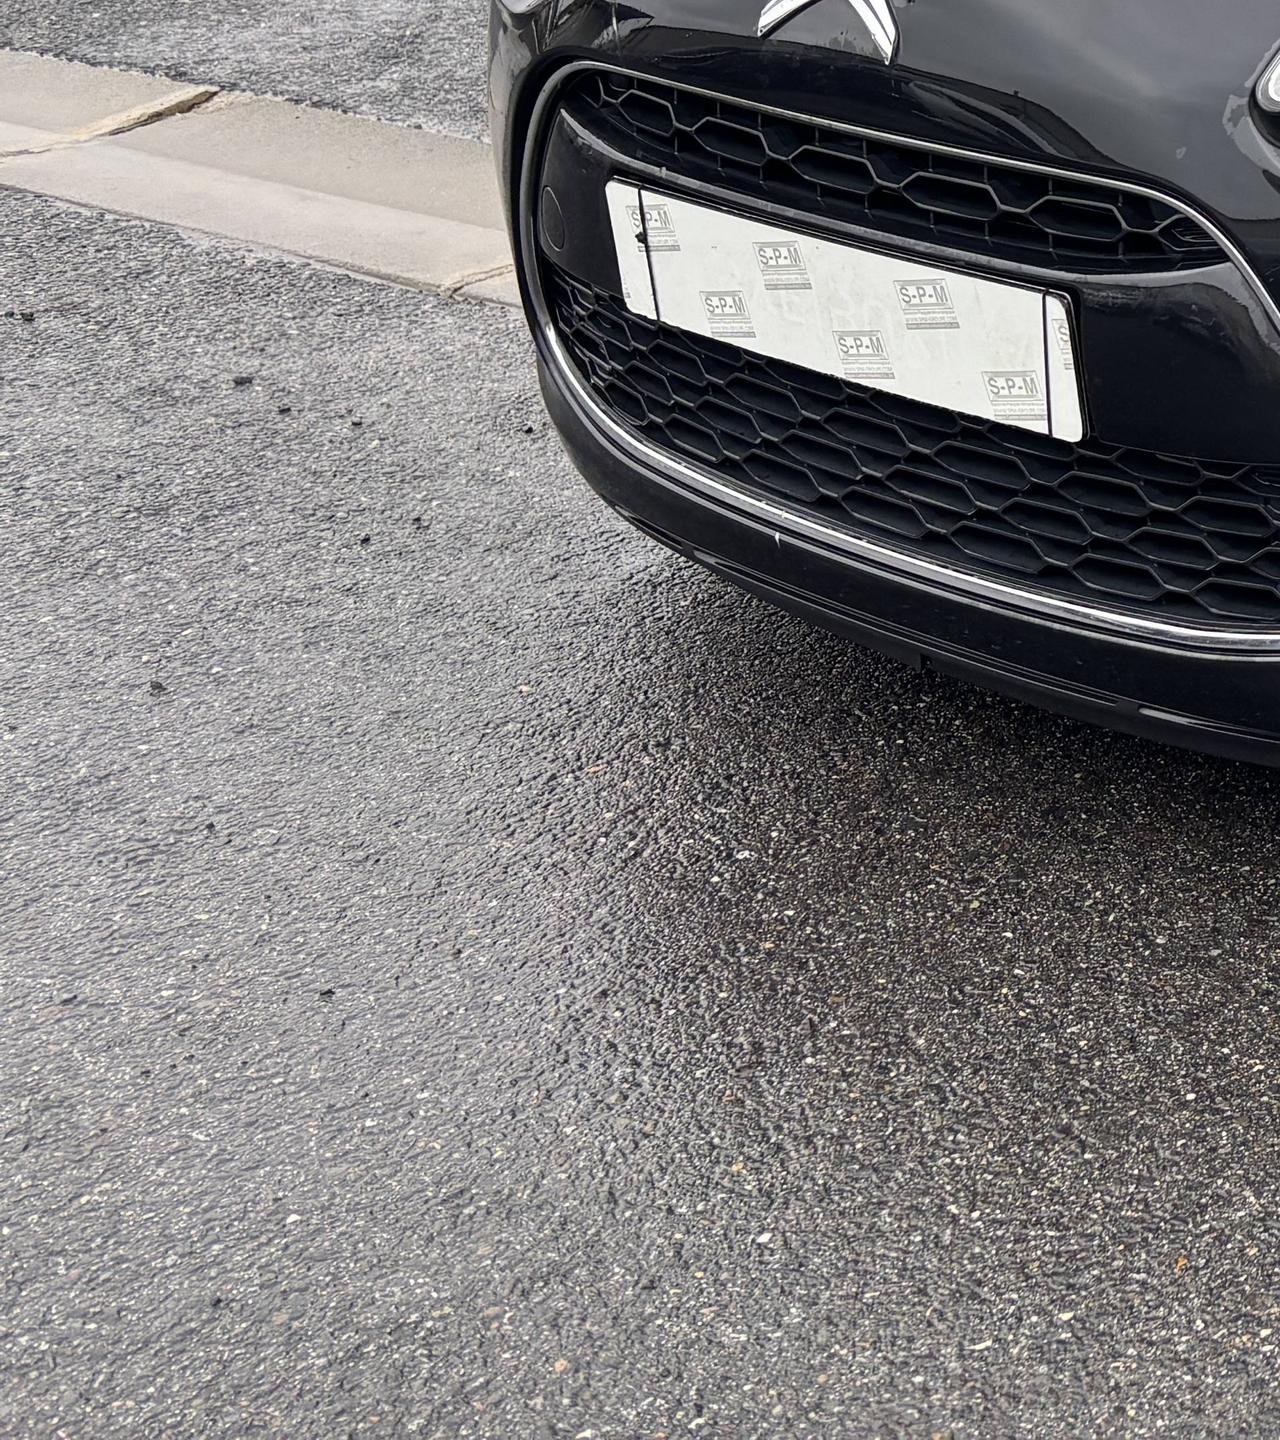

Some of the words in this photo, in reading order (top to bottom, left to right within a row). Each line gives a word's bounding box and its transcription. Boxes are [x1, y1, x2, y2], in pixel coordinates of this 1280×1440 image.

[632, 210, 671, 231] SP-M
[758, 247, 802, 265] S-P-M
[900, 285, 949, 304] S-P-M
[705, 296, 746, 314] S-P-M
[838, 336, 884, 354] S-P-M
[987, 377, 1039, 395] S-P-M
